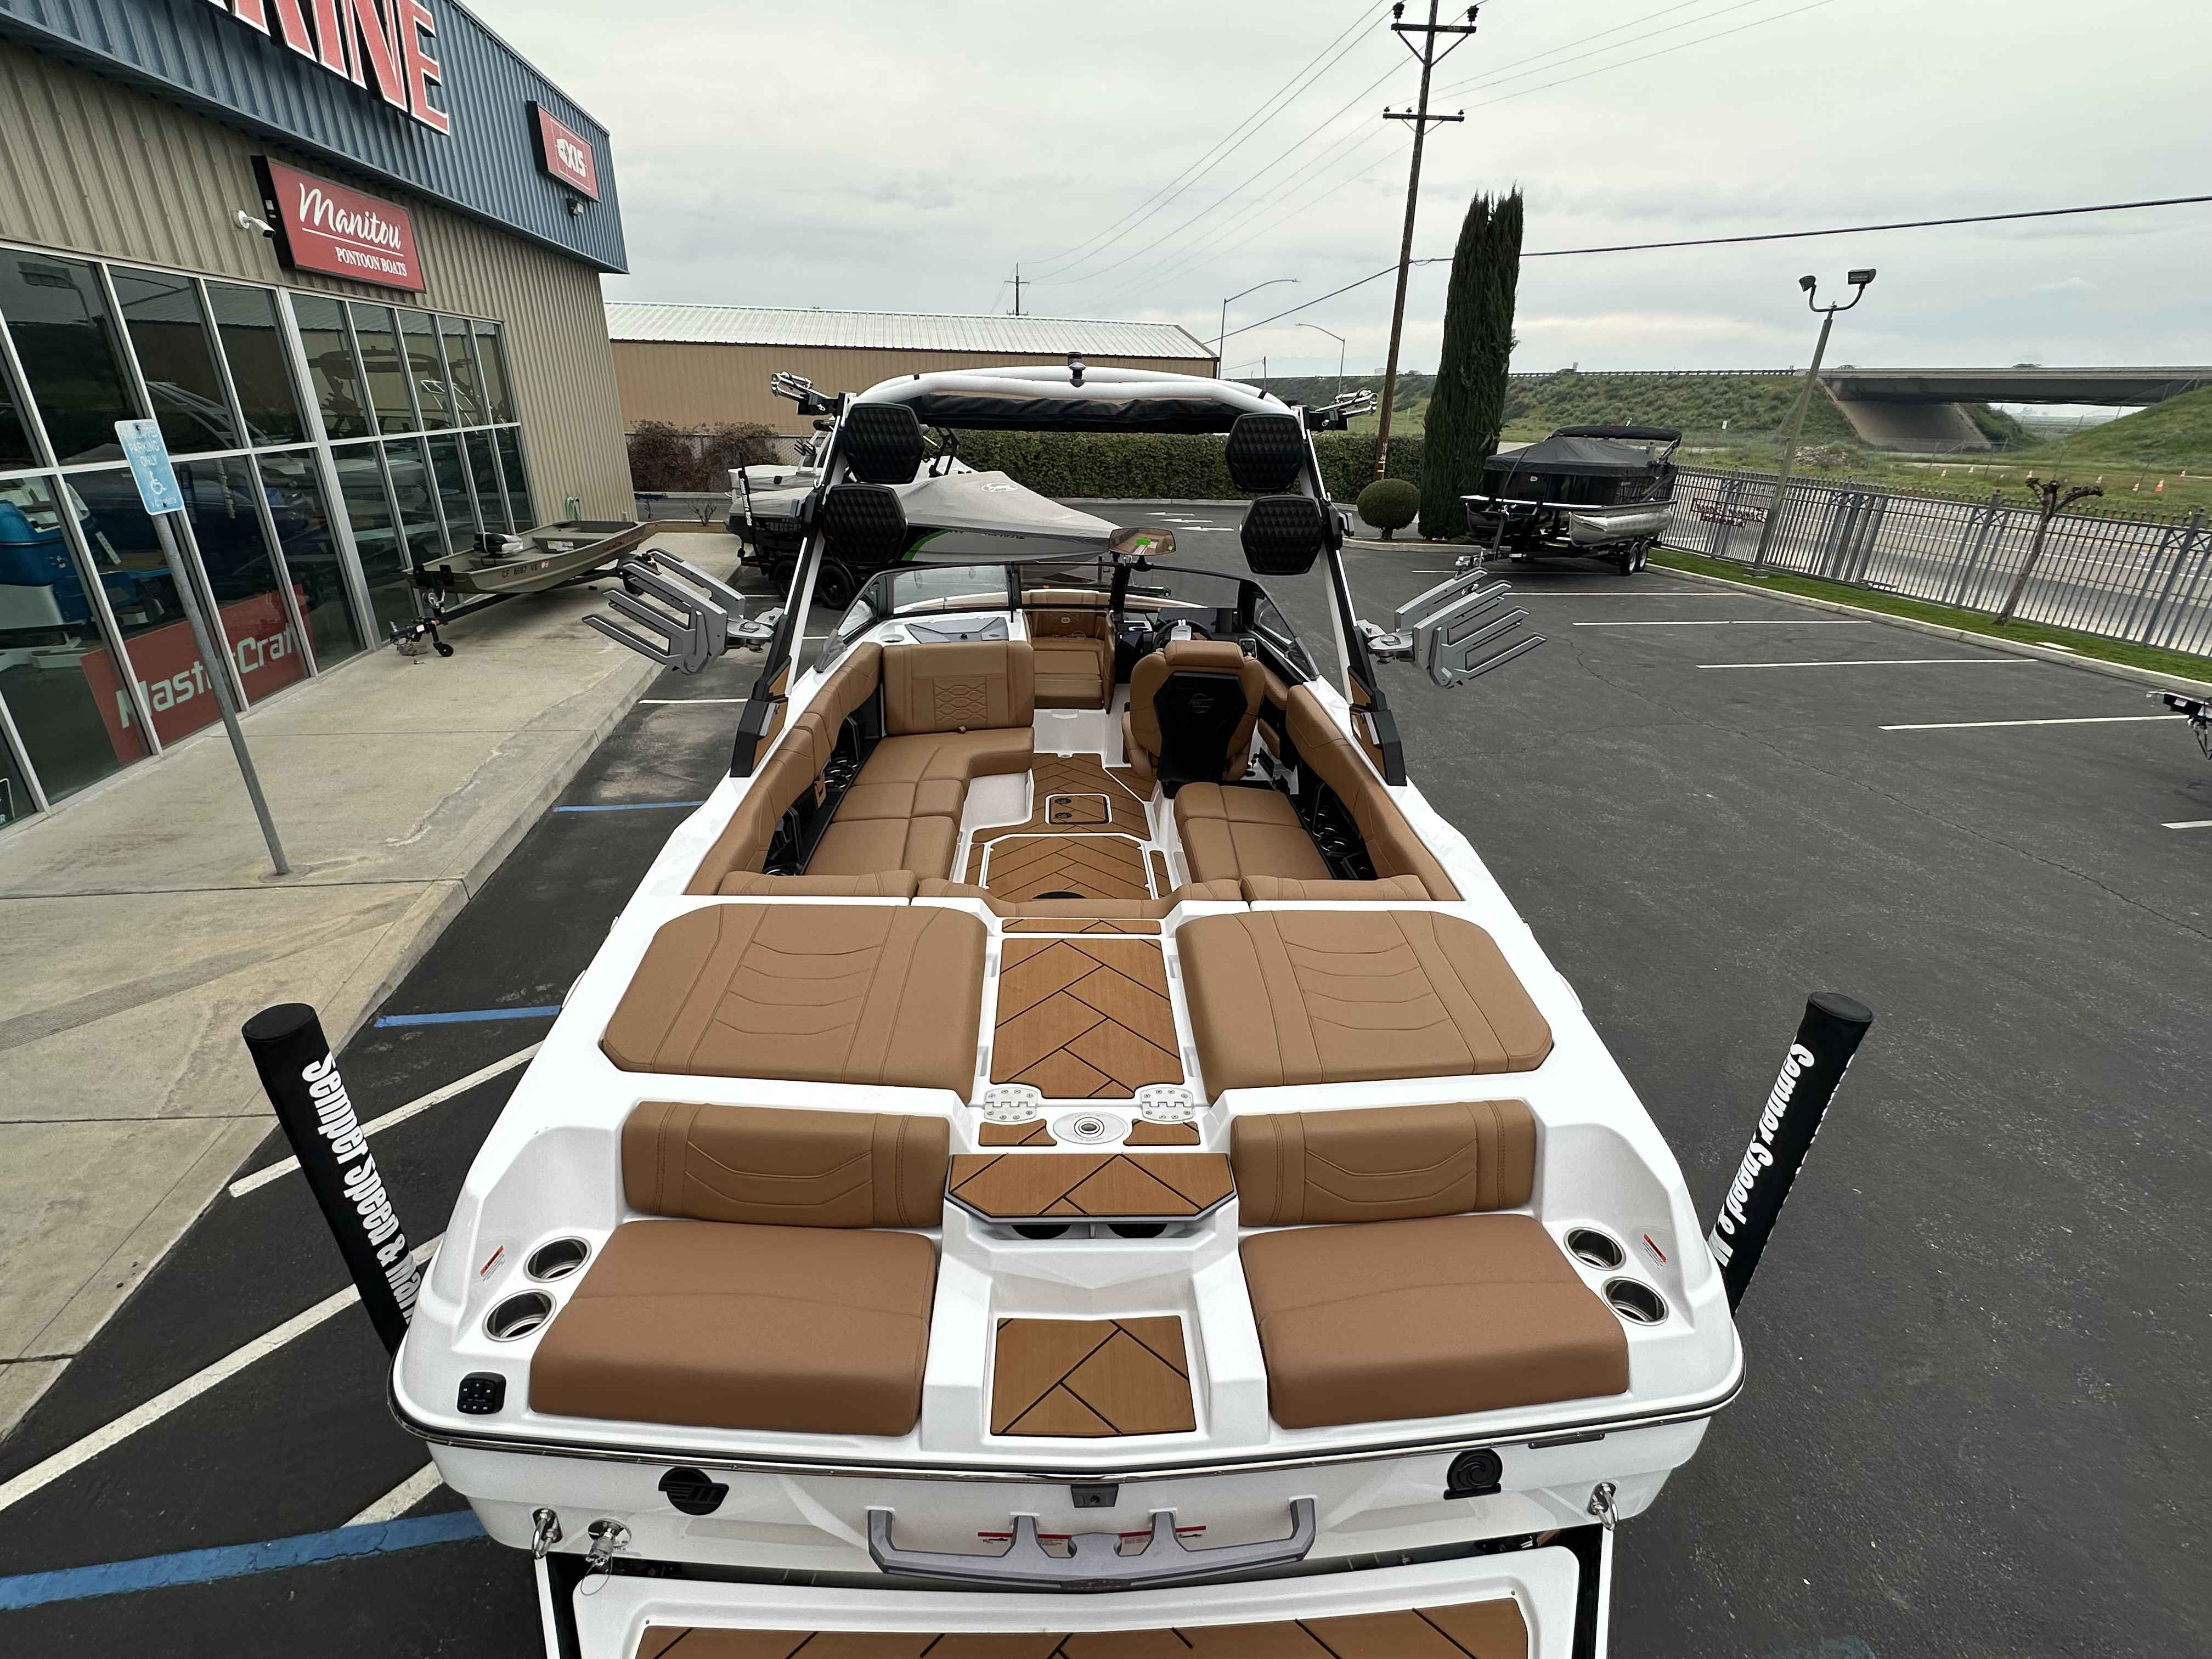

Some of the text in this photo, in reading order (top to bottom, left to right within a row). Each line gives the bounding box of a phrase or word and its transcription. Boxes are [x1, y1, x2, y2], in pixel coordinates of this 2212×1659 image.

[299, 183, 401, 249] Manitou
[335, 246, 408, 276] PONTOON BOATS
[302, 1051, 369, 1165] Semper
[343, 1153, 399, 1246] Speed
[376, 1233, 405, 1268] &
